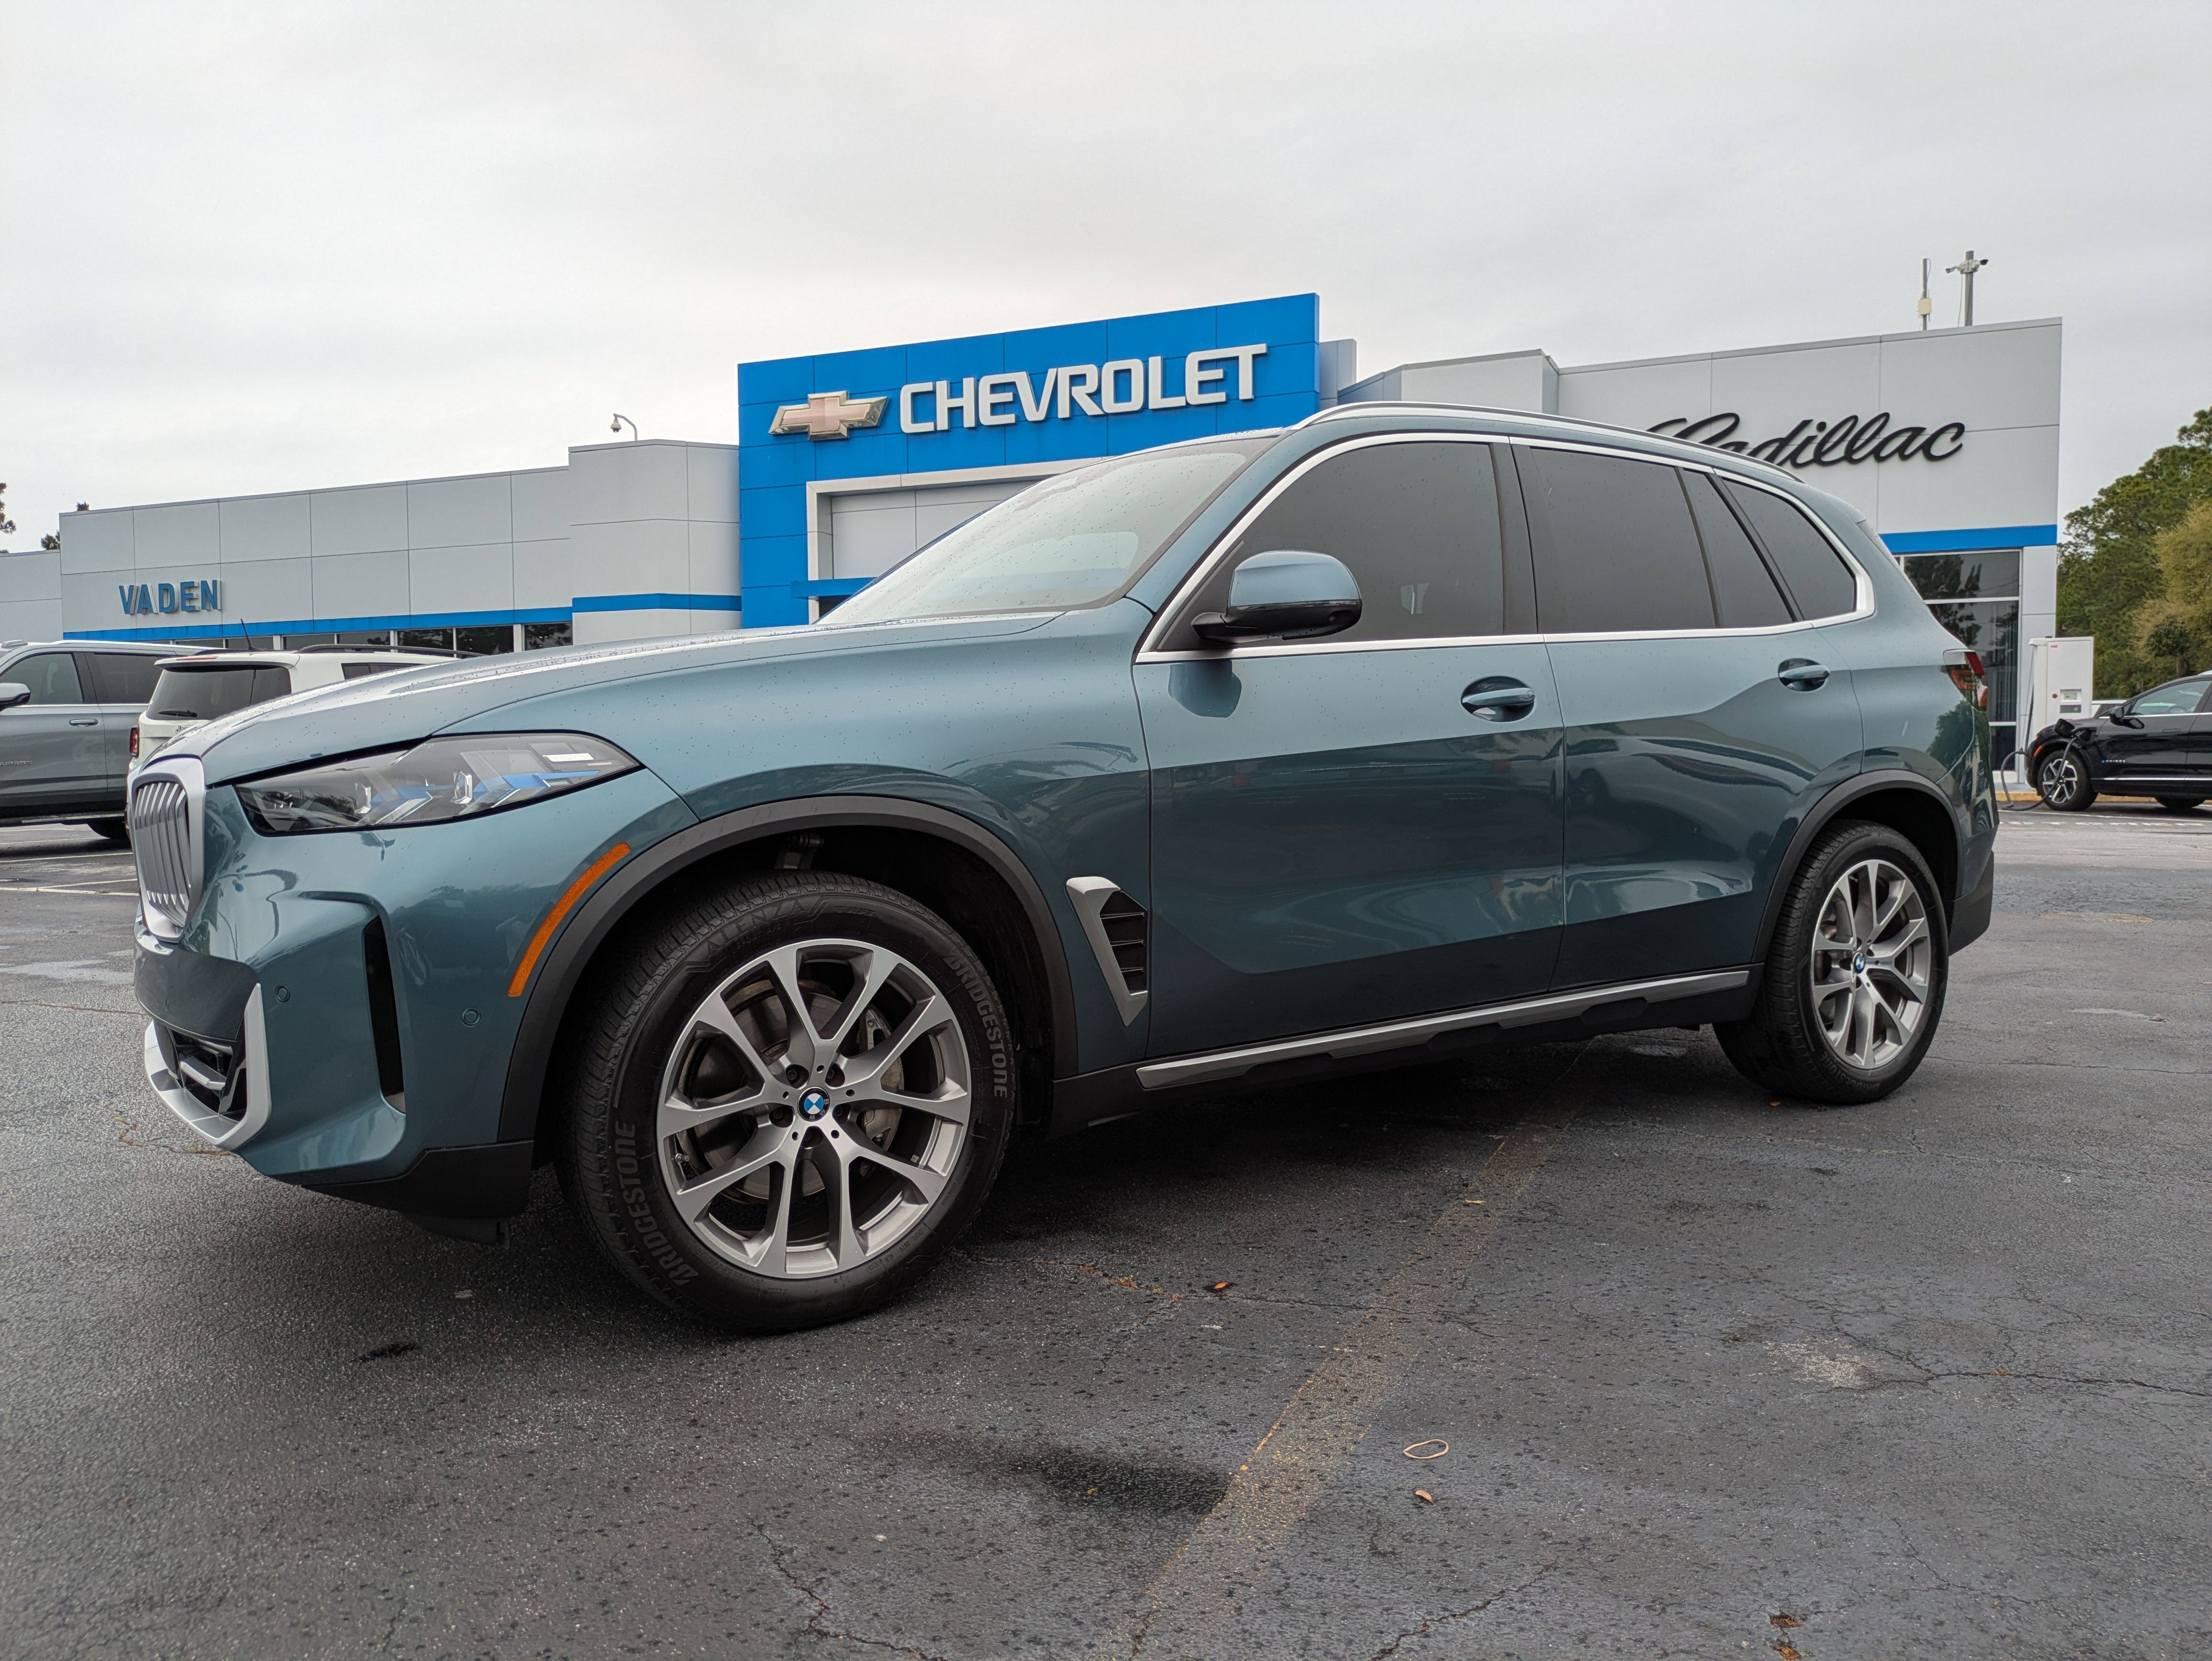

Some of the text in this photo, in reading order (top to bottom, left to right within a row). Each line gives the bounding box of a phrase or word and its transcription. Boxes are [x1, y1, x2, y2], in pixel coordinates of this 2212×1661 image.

[900, 343, 1267, 434] CHEVROLET
[119, 579, 222, 616] VADEN
[707, 899, 807, 957] ALENZA
[943, 947, 1008, 1098] BRIDGESTONE
[614, 1120, 700, 1286] BRIDGESTONE
